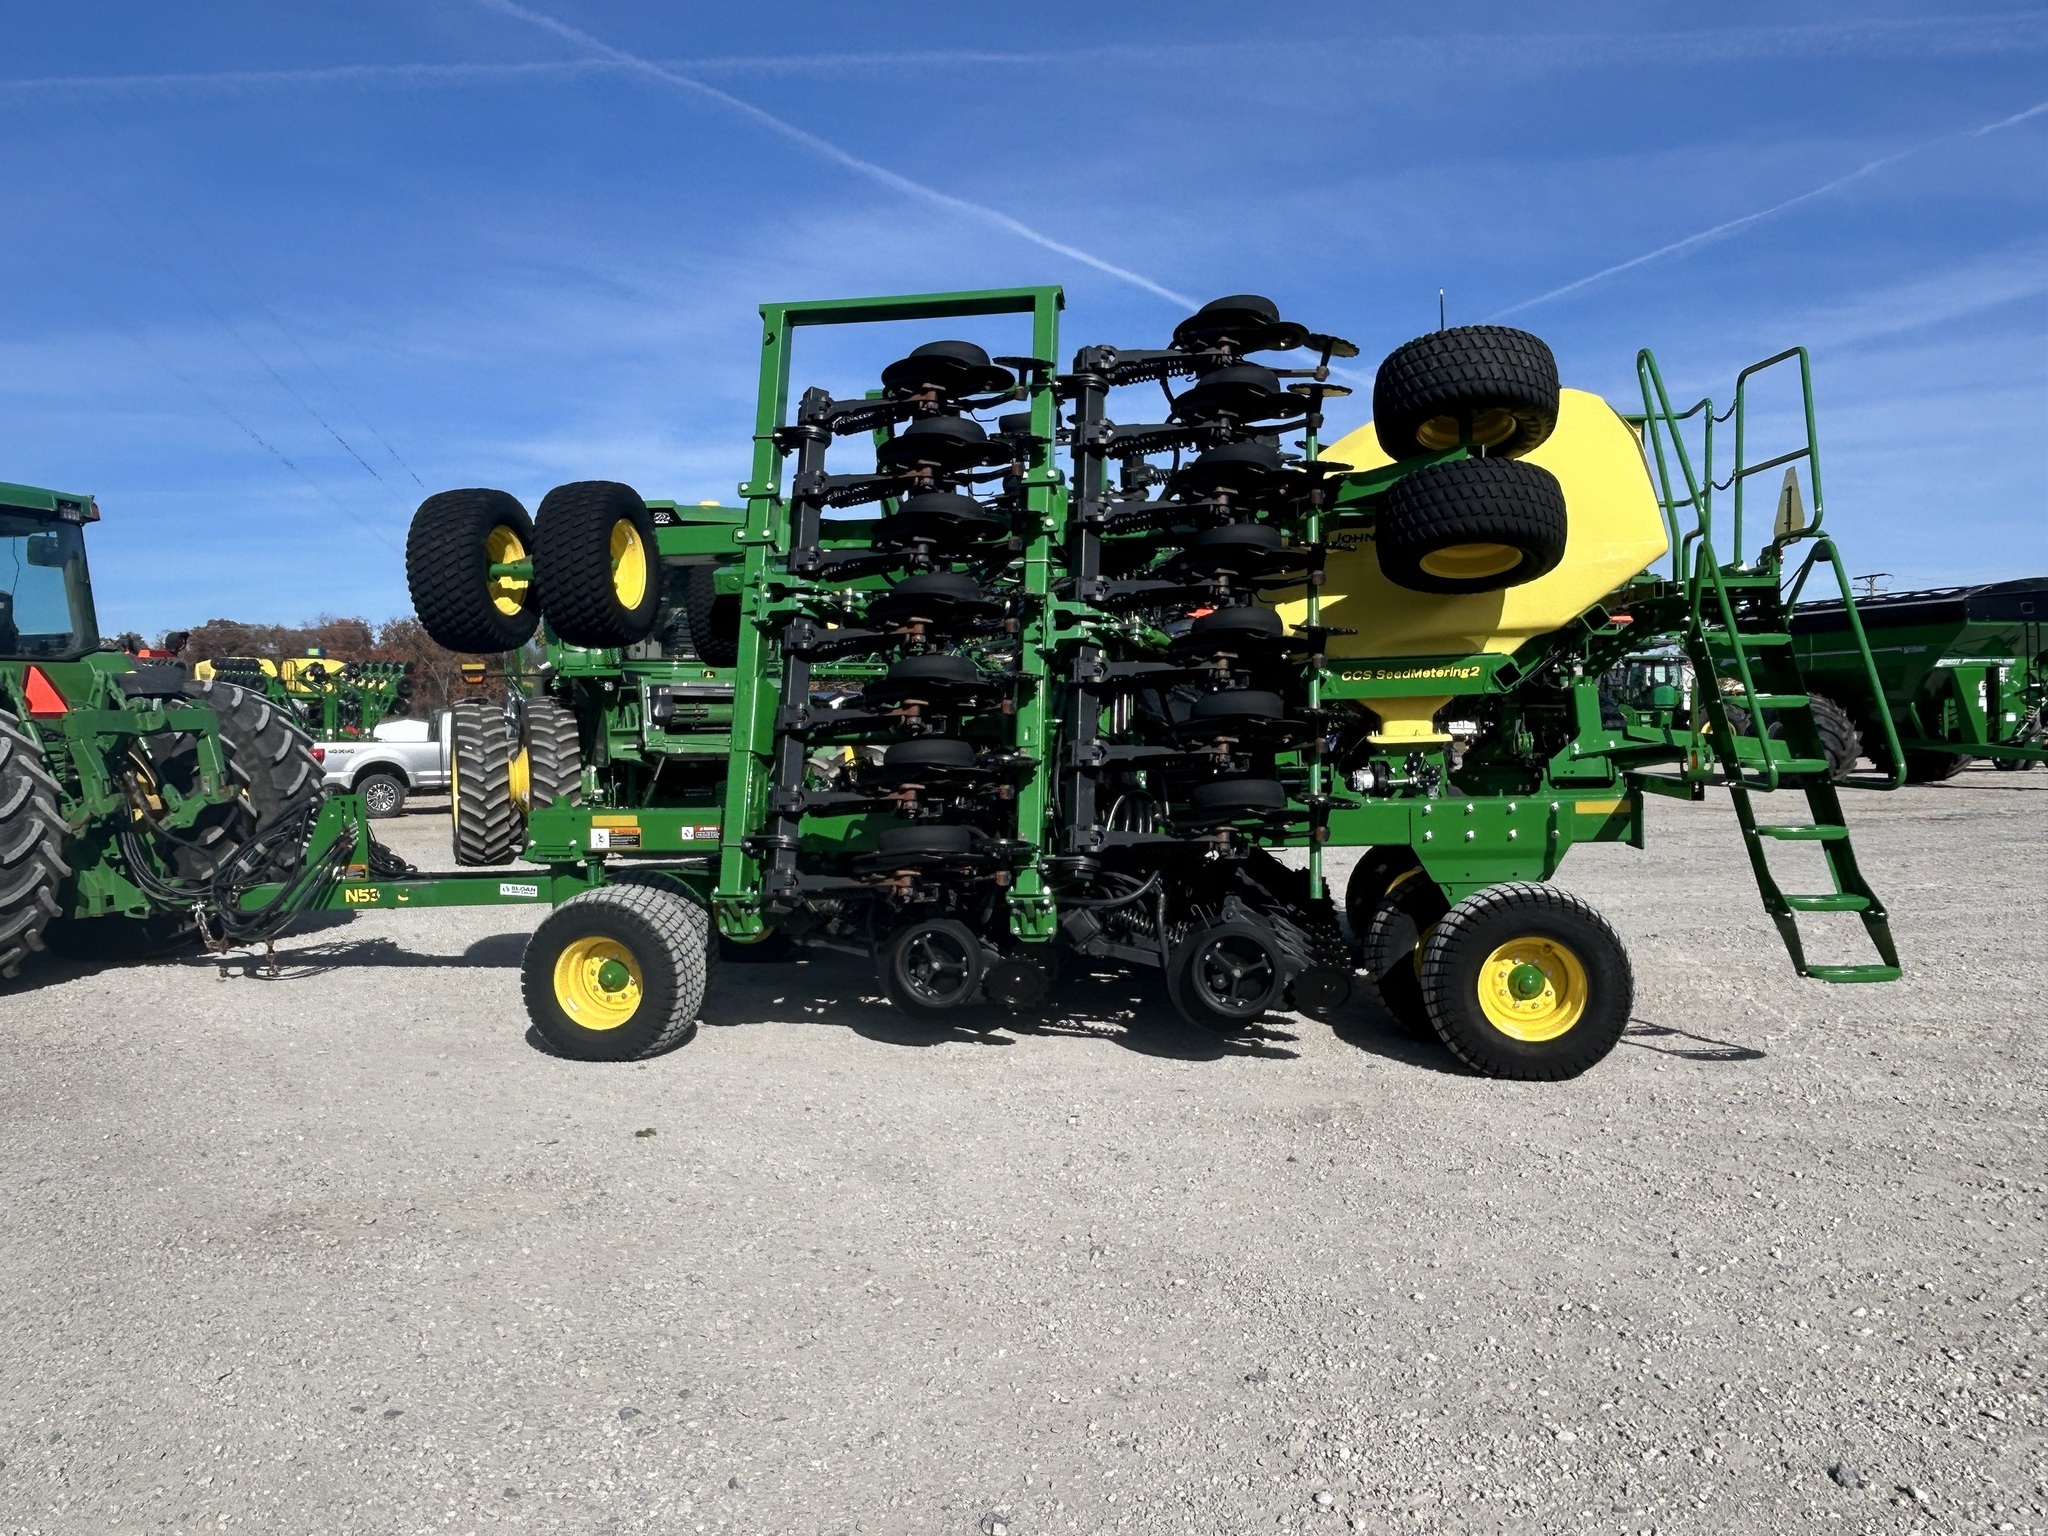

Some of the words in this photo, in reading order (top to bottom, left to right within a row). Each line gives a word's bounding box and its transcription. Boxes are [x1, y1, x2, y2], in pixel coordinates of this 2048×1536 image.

[1336, 533, 1376, 543] JOHN
[1341, 670, 1373, 681] CCS
[1375, 666, 1481, 680] SeedMetering2
